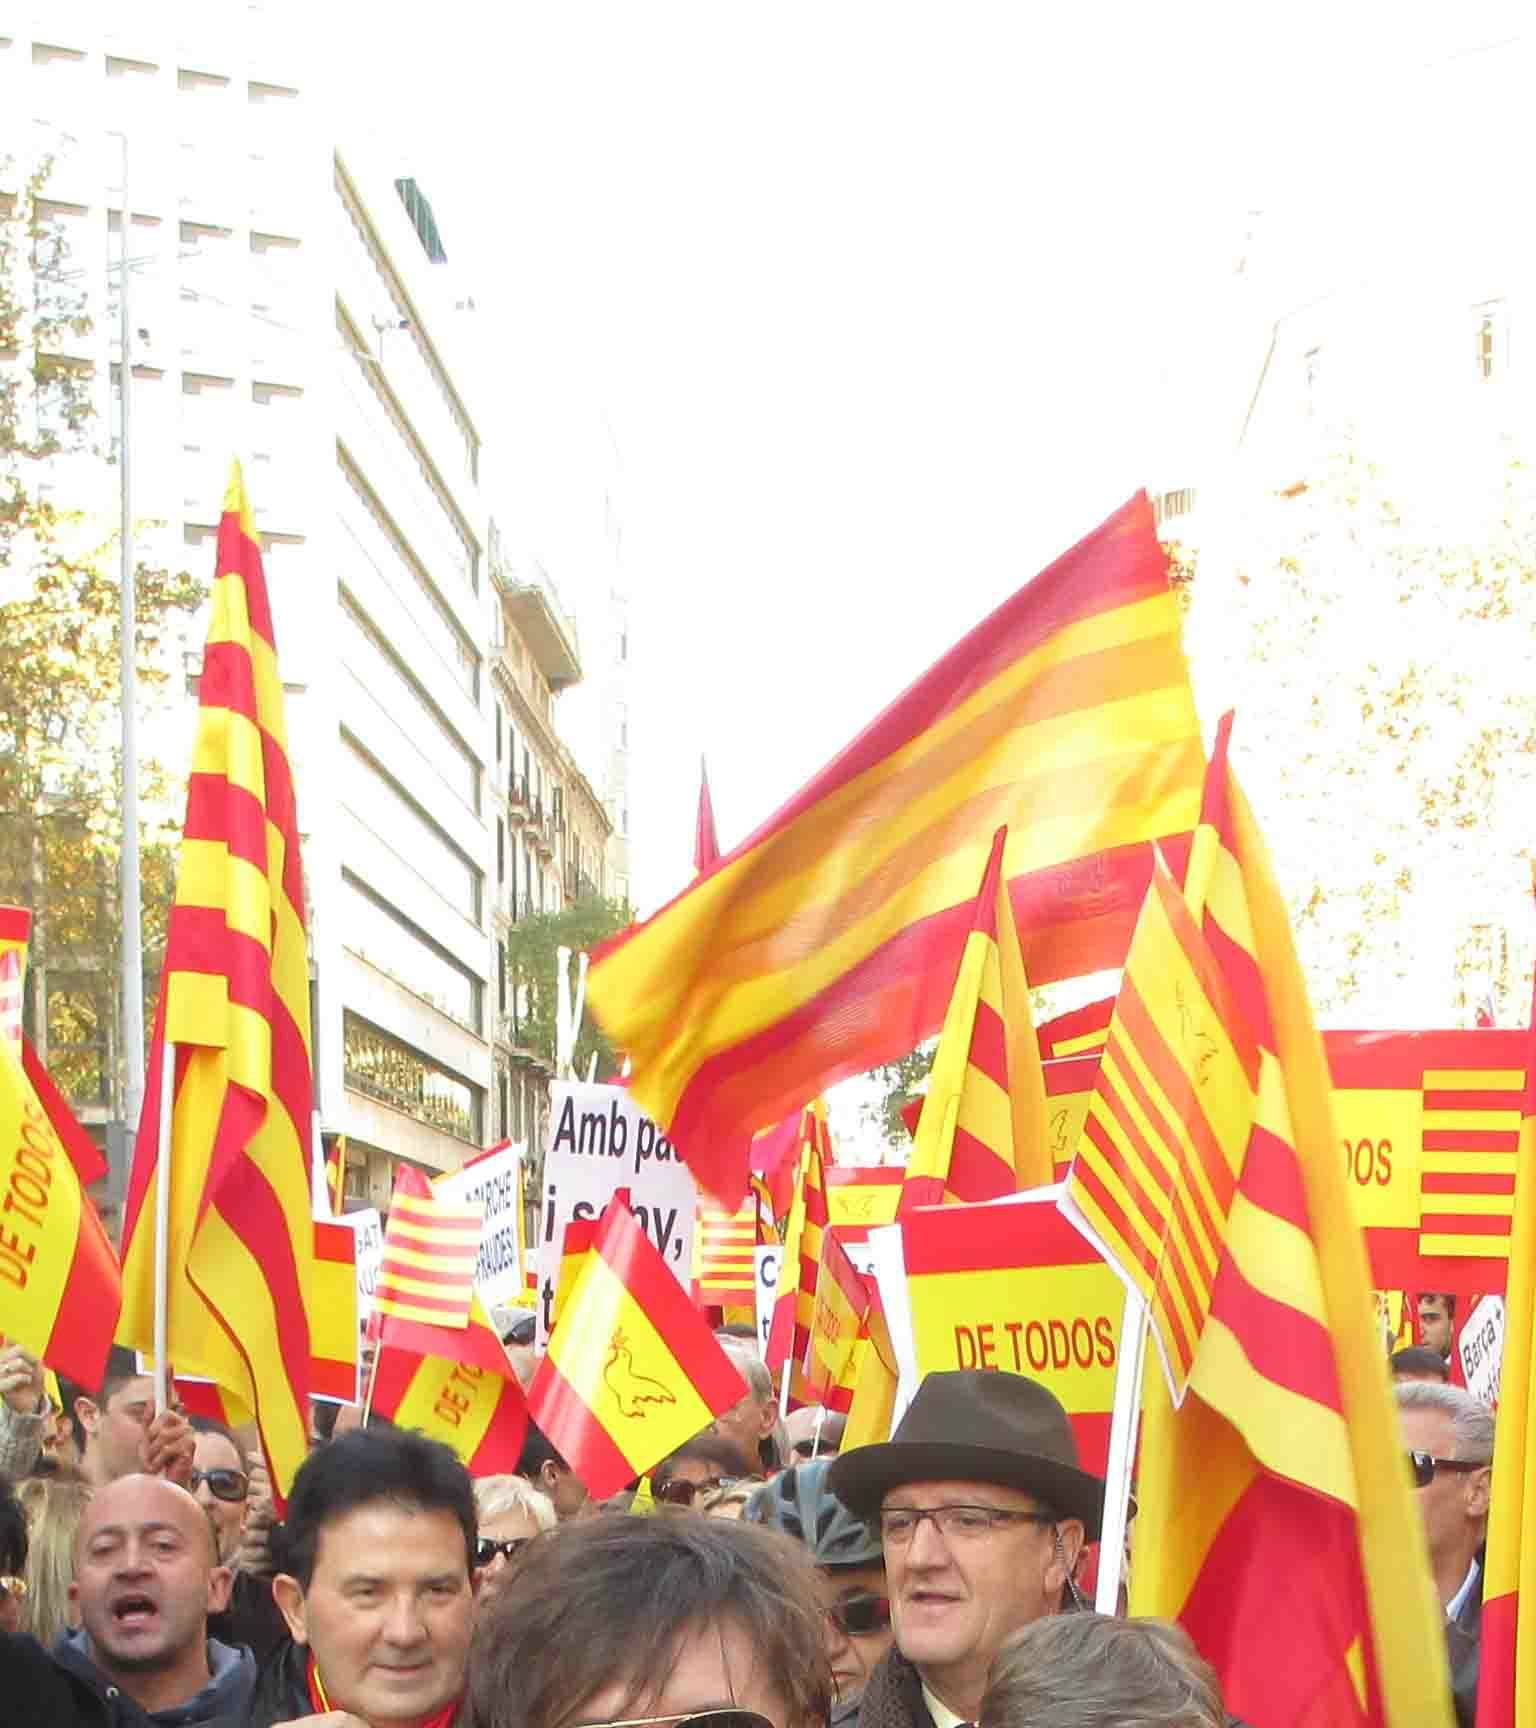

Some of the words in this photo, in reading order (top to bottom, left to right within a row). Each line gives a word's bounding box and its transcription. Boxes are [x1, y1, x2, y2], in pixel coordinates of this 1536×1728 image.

[552, 1095, 627, 1158] Amb
[544, 1184, 557, 1242] i
[954, 1323, 999, 1372] DE
[1004, 1316, 1116, 1372] TODOS
